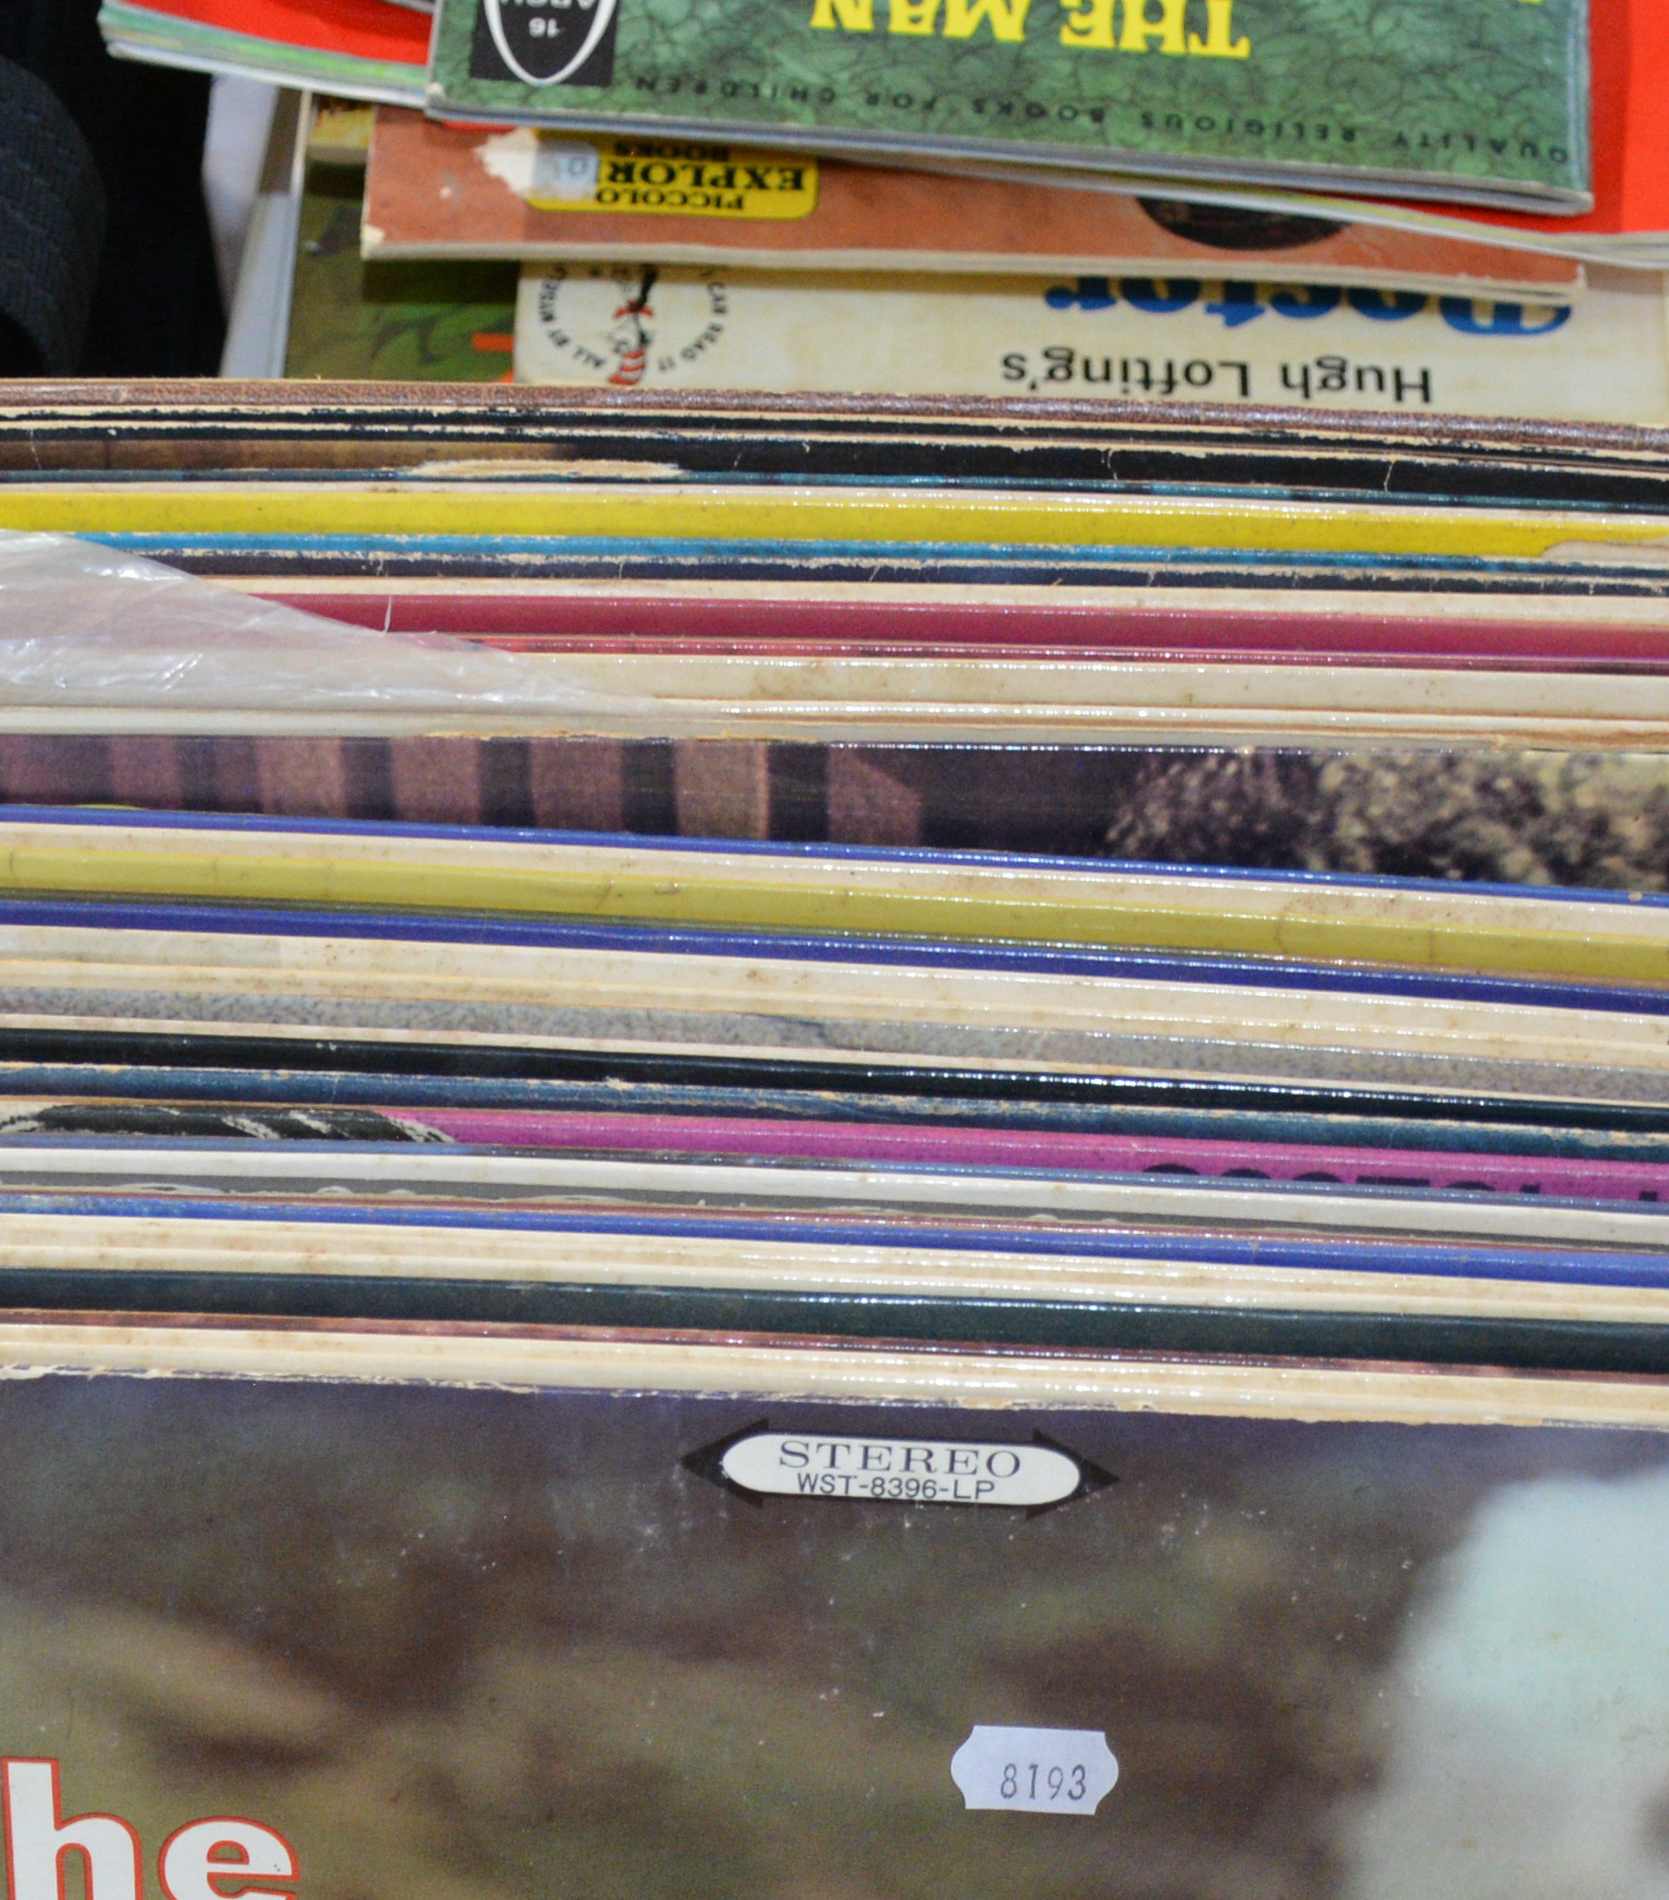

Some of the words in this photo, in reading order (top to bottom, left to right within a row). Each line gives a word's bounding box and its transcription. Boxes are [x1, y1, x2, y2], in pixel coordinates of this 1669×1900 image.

[529, 17, 558, 38] 16
[1059, 0, 1250, 58] THE
[635, 76, 836, 103] CHILDREN
[866, 92, 937, 111] FOR
[973, 97, 1105, 124] BOOKS
[1141, 111, 1356, 142] RELIGIOUS
[614, 140, 729, 162] BOOKS
[1393, 128, 1568, 164] QUALITY
[608, 159, 804, 190] EXPLOR
[597, 188, 744, 209] PICCOLO
[1001, 346, 1251, 398] Lofting's
[1280, 357, 1432, 403] Hugh
[779, 1440, 1021, 1479] STEREO
[797, 1472, 995, 1501] WST-8396-LP
[1000, 1763, 1088, 1801] 8193
